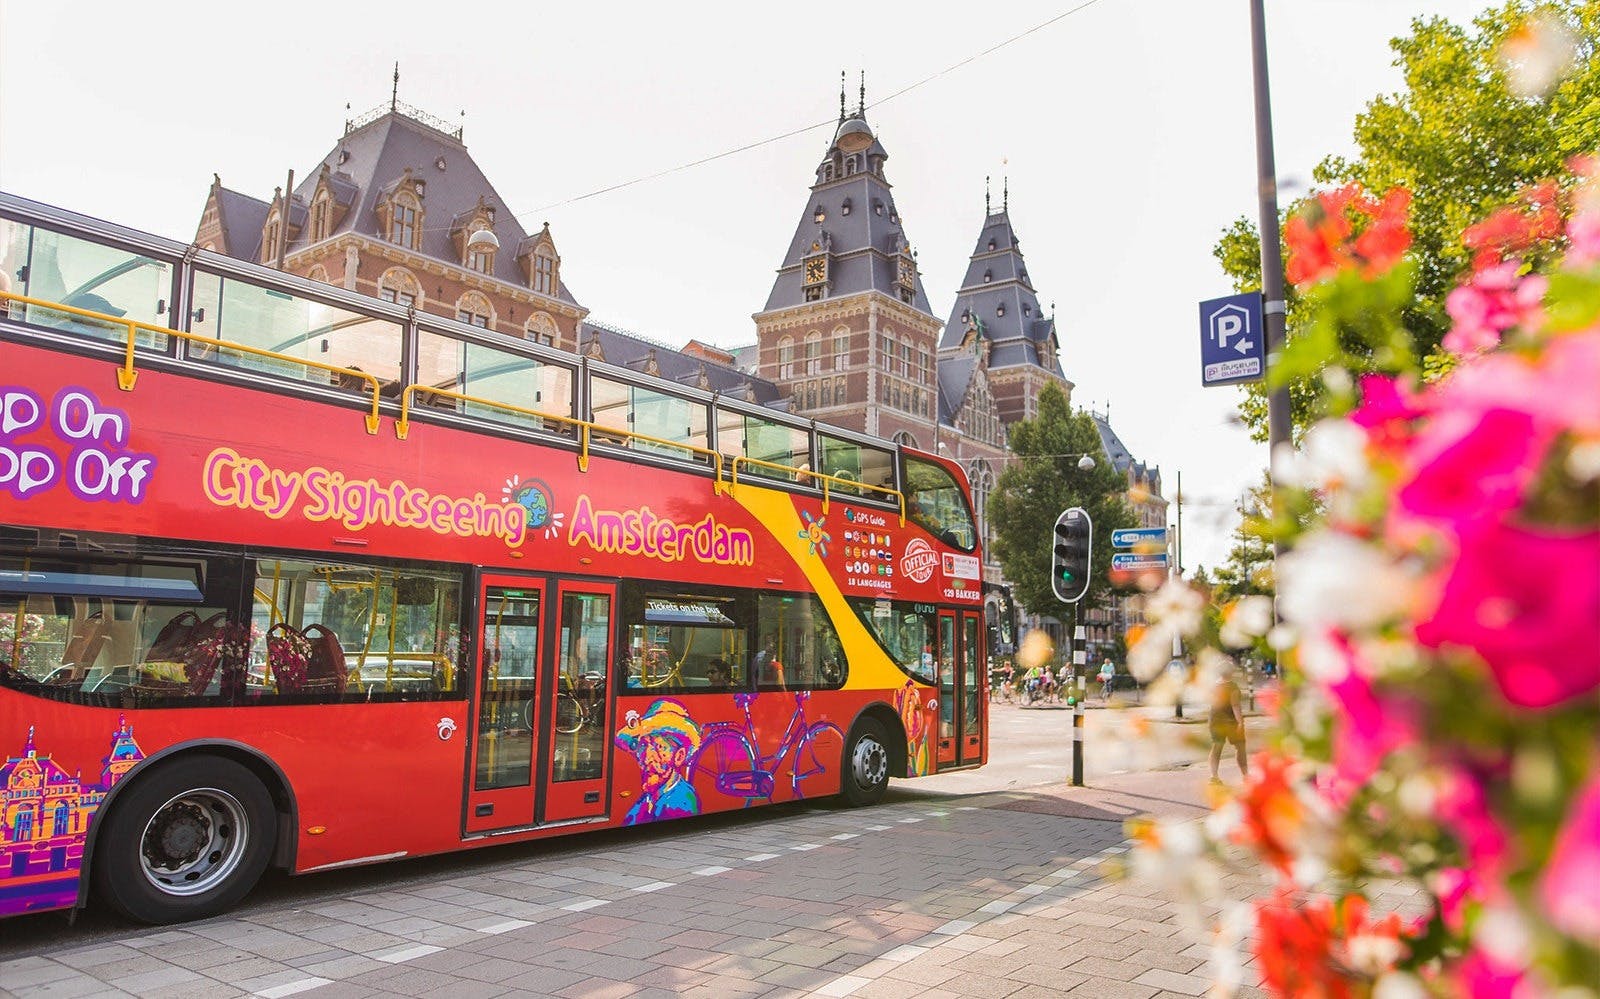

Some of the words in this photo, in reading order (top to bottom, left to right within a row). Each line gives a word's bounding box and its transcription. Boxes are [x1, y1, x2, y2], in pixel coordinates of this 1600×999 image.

[1218, 314, 1242, 348] P
[59, 391, 123, 443] On
[74, 448, 152, 498] Off
[203, 447, 301, 519] City
[303, 466, 526, 548] Sightseeing
[568, 494, 754, 566] Amsterdam
[856, 511, 869, 524] GPS
[869, 514, 886, 527] Guide
[904, 553, 937, 573] OFFICIAL
[857, 579, 892, 589] LANGUAGES
[955, 589, 980, 600] BAKKER
[647, 601, 679, 611] Tickets
[679, 604, 691, 612] on
[690, 604, 705, 613] the
[705, 605, 721, 614] bus
